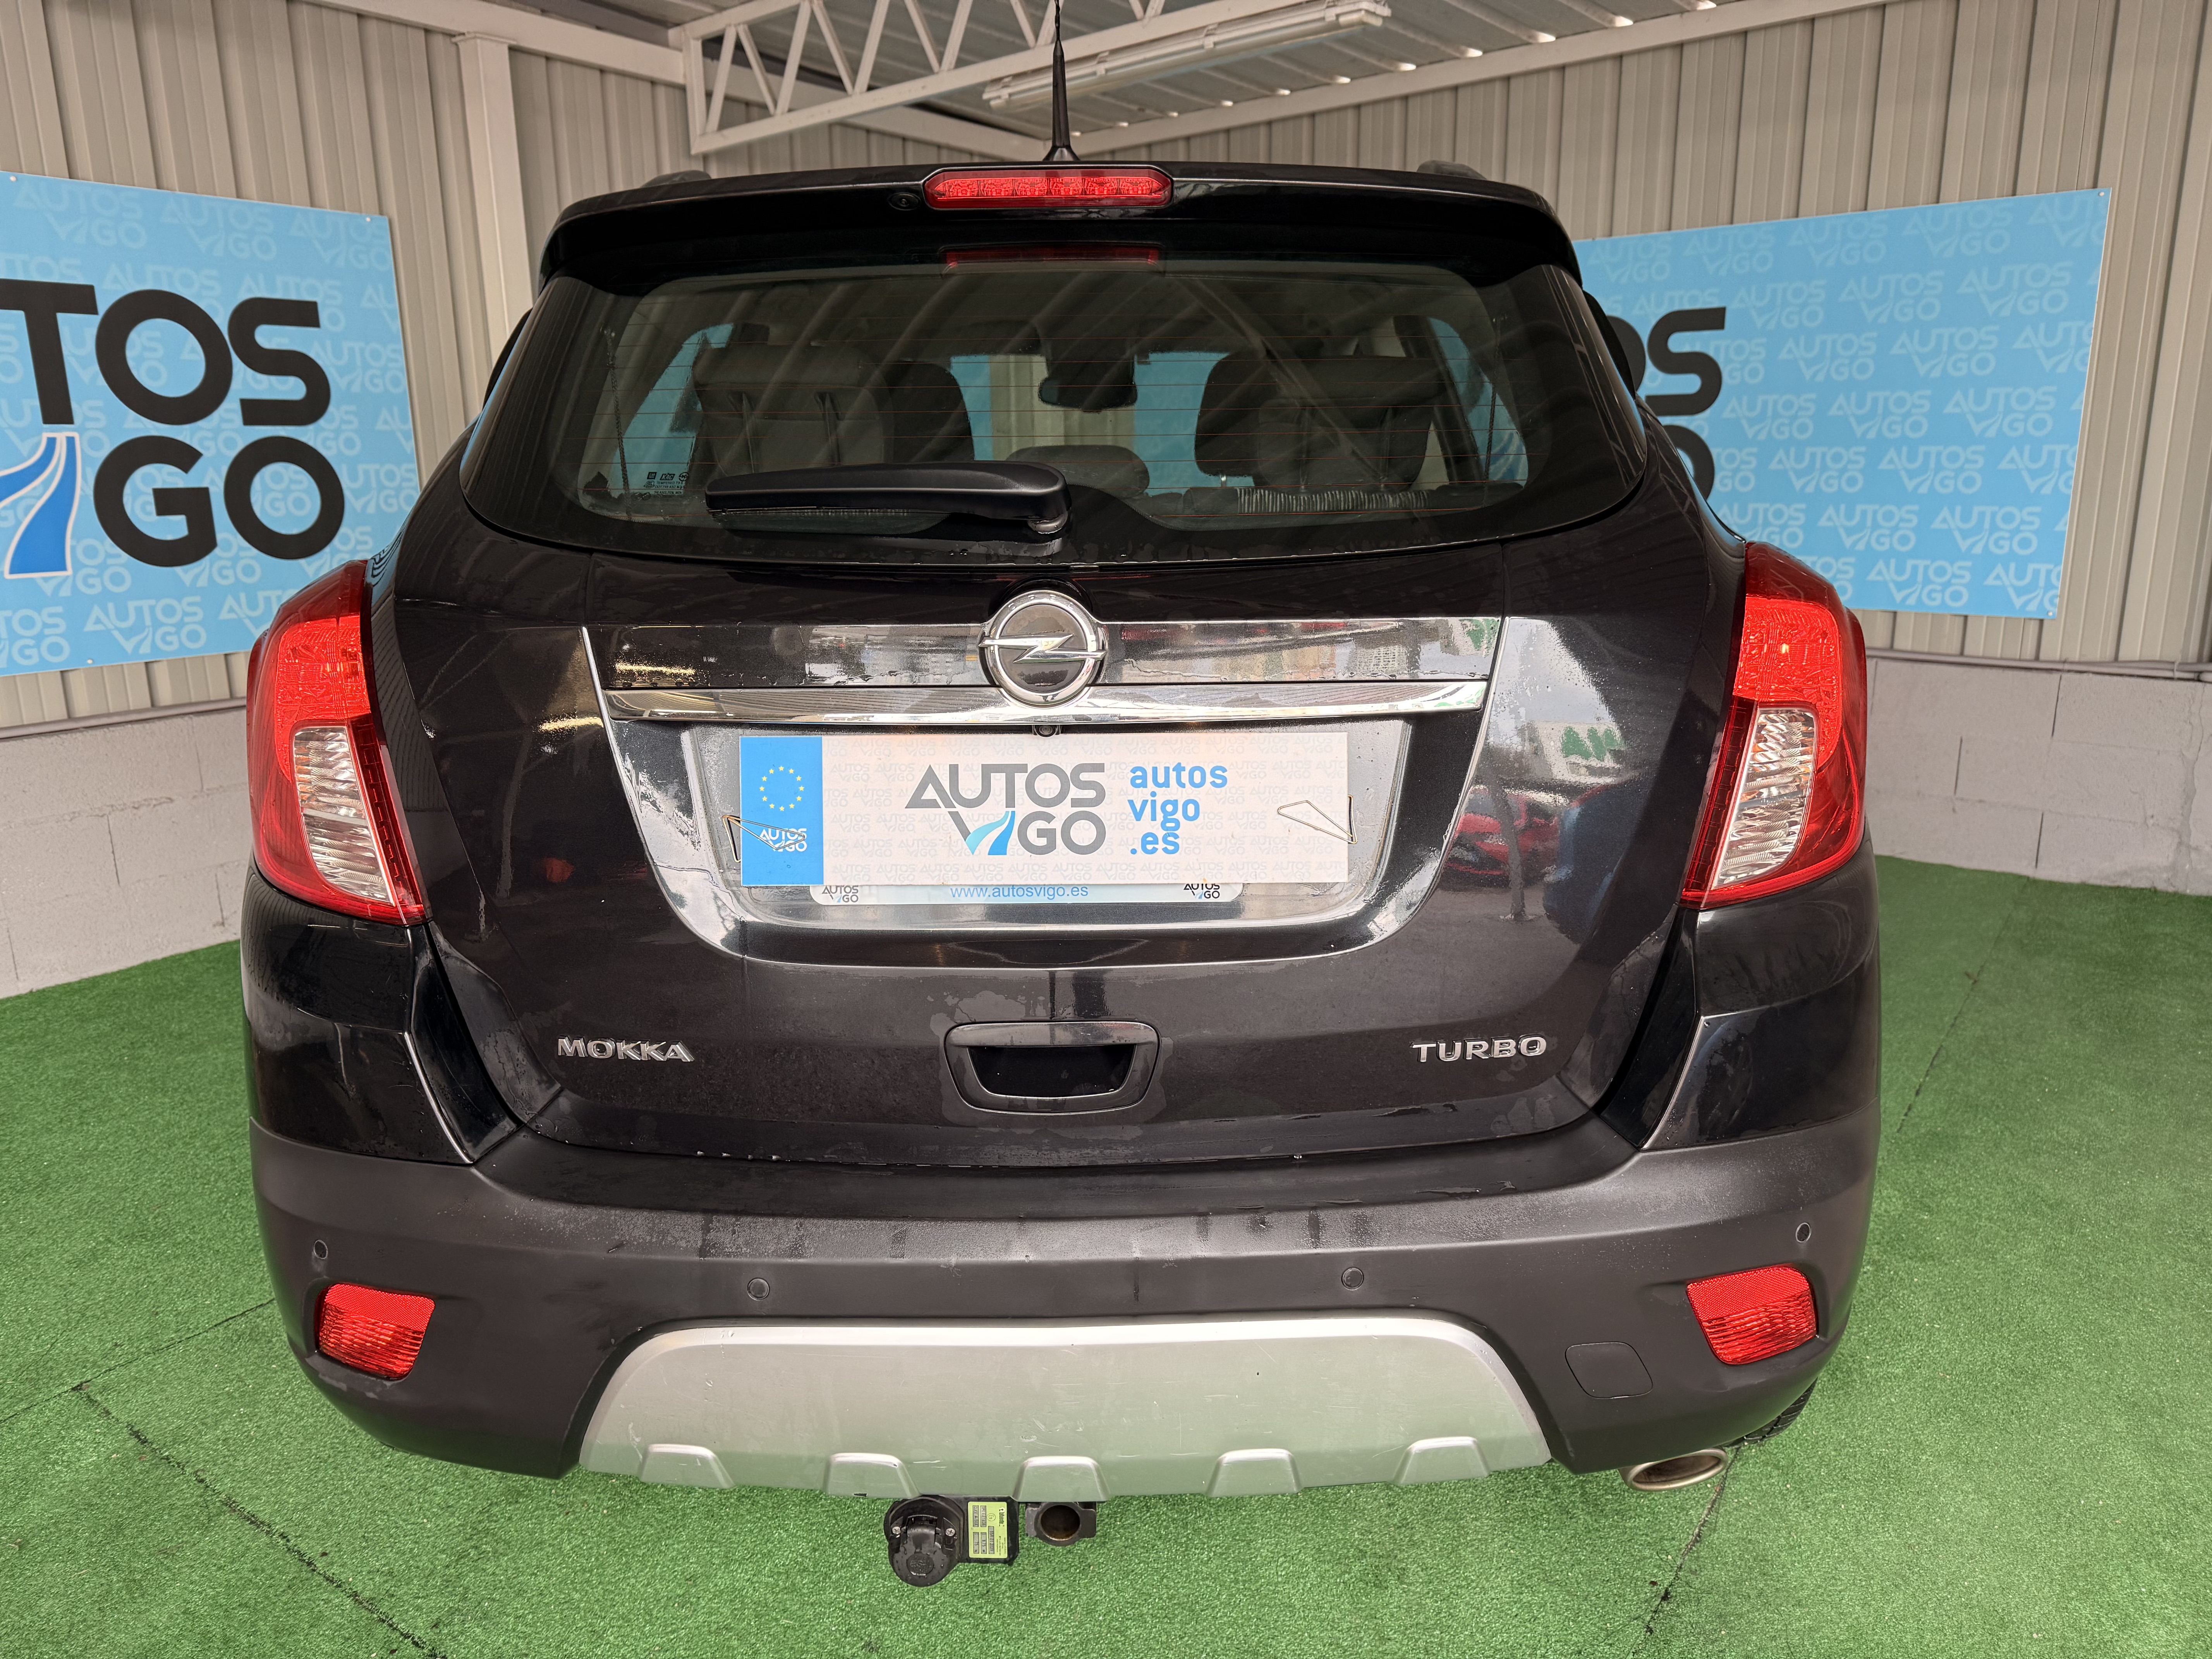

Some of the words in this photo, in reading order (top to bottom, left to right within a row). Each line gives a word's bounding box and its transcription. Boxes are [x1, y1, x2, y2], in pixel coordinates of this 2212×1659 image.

[14, 182, 143, 220] AUTOS
[160, 198, 273, 232] AUTOS
[1903, 203, 2013, 235] AUTOS
[1839, 271, 1945, 302] AUTOS
[1956, 261, 2074, 294] AUTOS
[1731, 279, 1826, 309] AUTOS
[1978, 289, 2069, 317] VIGO
[1750, 305, 1824, 330] VIGO
[1860, 297, 1941, 323] VIGO
[0, 278, 331, 426] TOS
[1778, 332, 1878, 360] AUTOS
[1889, 325, 2001, 355] AUTOS
[1798, 357, 1875, 382] VIGO
[1911, 352, 1996, 378] VIGO
[1721, 393, 1816, 419] AUTOS
[1827, 389, 1932, 416] AUTOS
[1943, 386, 2057, 414] AUTOS
[1741, 417, 1814, 440] VIGO
[1848, 415, 1929, 439] VIGO
[1966, 412, 2054, 438] VIGO
[1769, 446, 1867, 469] AUTOS
[1877, 445, 1986, 470] AUTOS
[343, 464, 416, 489] UTOS
[1788, 470, 1864, 494] VIGO
[1899, 469, 1982, 495] VIGO
[1718, 503, 1807, 527] AUTOS
[1817, 503, 1920, 527] AUTOS
[1930, 505, 2042, 531] AUTOS
[1837, 527, 1916, 552] VIGO
[1953, 529, 2039, 556] VIGO
[1866, 558, 1973, 583] AUTOS
[219, 589, 297, 620] AUT
[1889, 582, 1969, 608] VIGO
[84, 595, 203, 631] AUTOS
[111, 623, 206, 654] VIGO
[905, 763, 1106, 809] AUTOS
[1130, 762, 1228, 789] autos
[1127, 791, 1200, 832] vigo
[759, 828, 807, 840] AUTOS
[948, 811, 1106, 855] VIGO
[1130, 831, 1180, 855] .es
[822, 885, 859, 895] AUTOS
[950, 885, 1088, 900] www.autosvigo.es
[558, 1036, 694, 1062] MOKKA
[1410, 1034, 1546, 1062] TURBO
